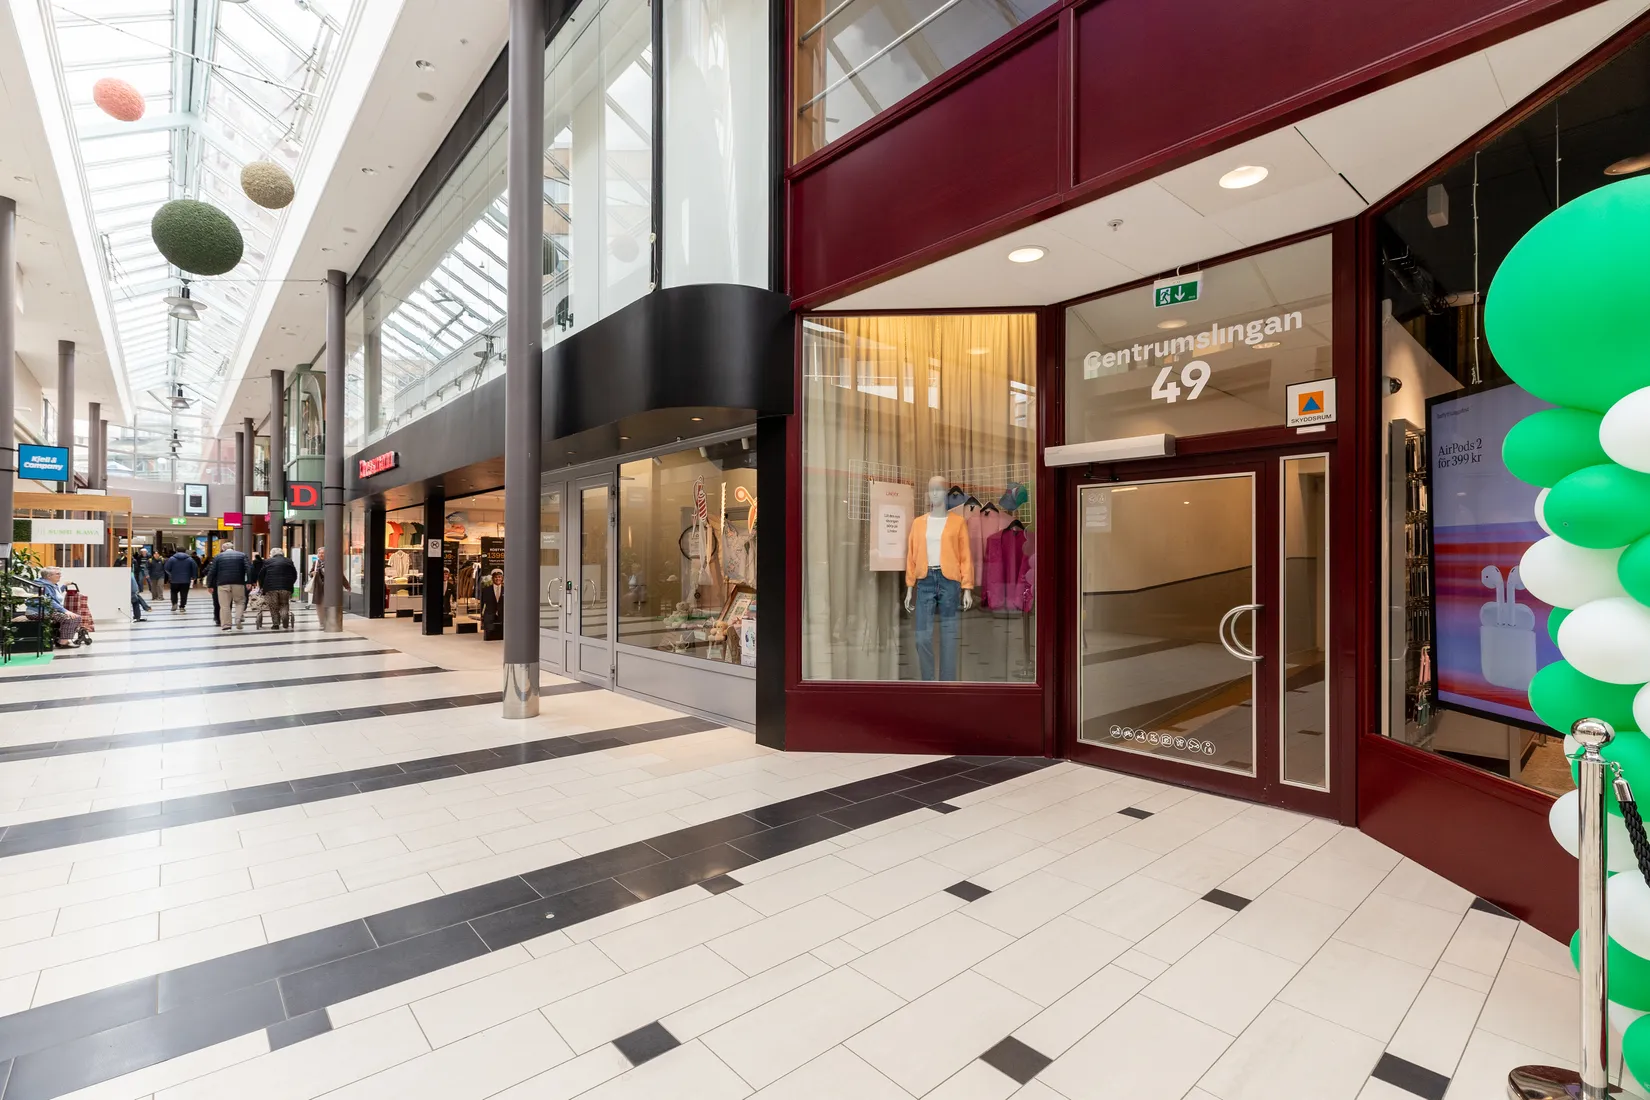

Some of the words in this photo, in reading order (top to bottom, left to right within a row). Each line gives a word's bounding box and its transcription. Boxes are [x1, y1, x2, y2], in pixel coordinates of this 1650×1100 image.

[1084, 311, 1303, 373] Centrumslingan
[1151, 360, 1211, 404] 49
[1290, 414, 1332, 424] SKYDDSRUM
[1438, 440, 1475, 456] AirPods
[1476, 437, 1482, 450] 2
[23, 461, 63, 471] Company
[31, 455, 50, 463] Kjell
[1438, 457, 1451, 469] för
[1452, 453, 1469, 466] 399
[1471, 452, 1482, 464] kr
[290, 484, 318, 507] D
